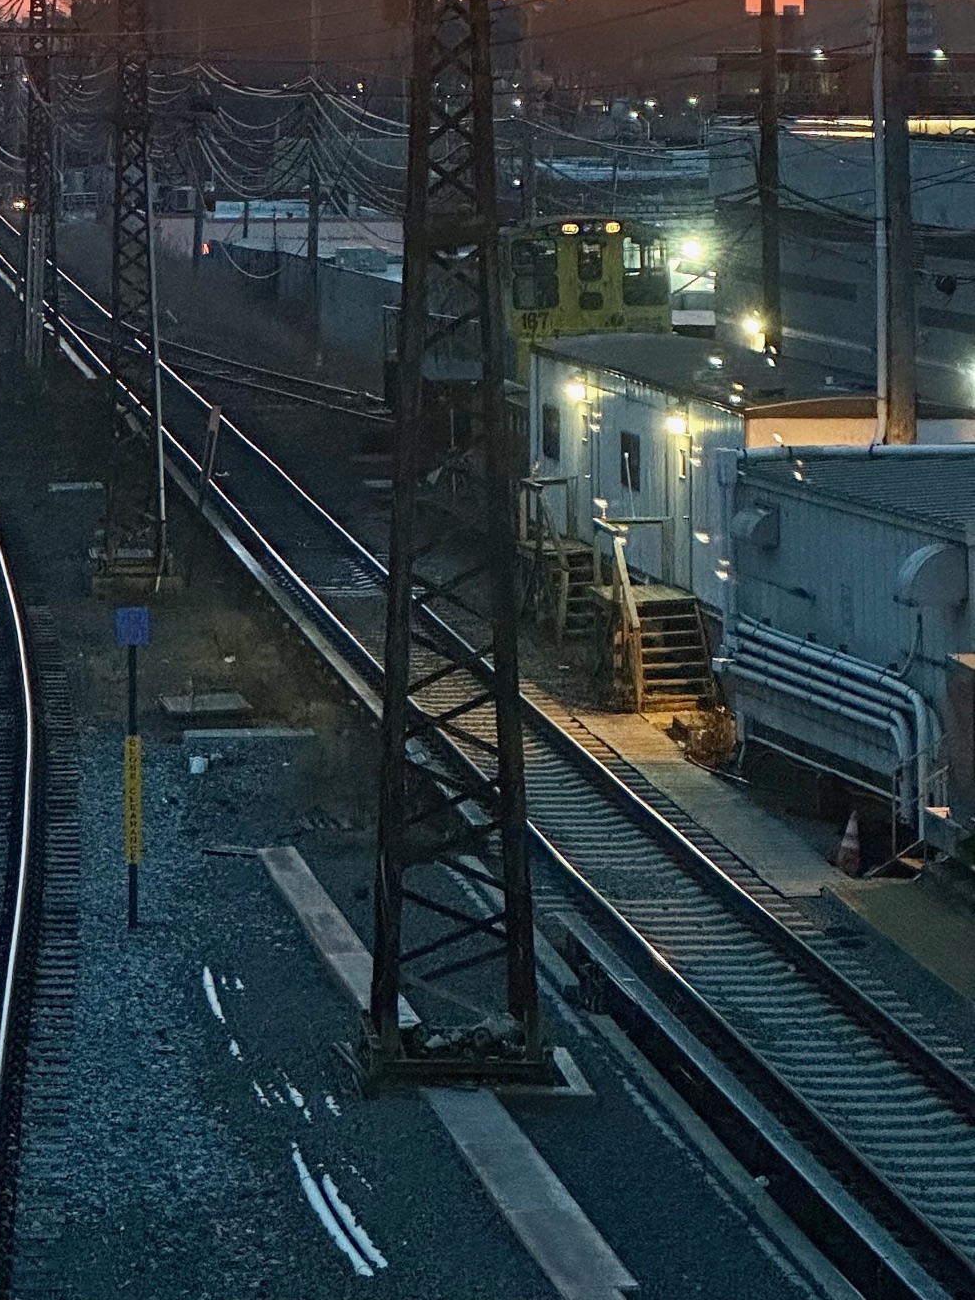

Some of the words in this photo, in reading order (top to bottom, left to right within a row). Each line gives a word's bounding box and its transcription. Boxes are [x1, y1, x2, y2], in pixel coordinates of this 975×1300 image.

[521, 312, 550, 330] 167
[128, 739, 137, 779] CLOSE
[128, 787, 137, 860] CLEARANCE
